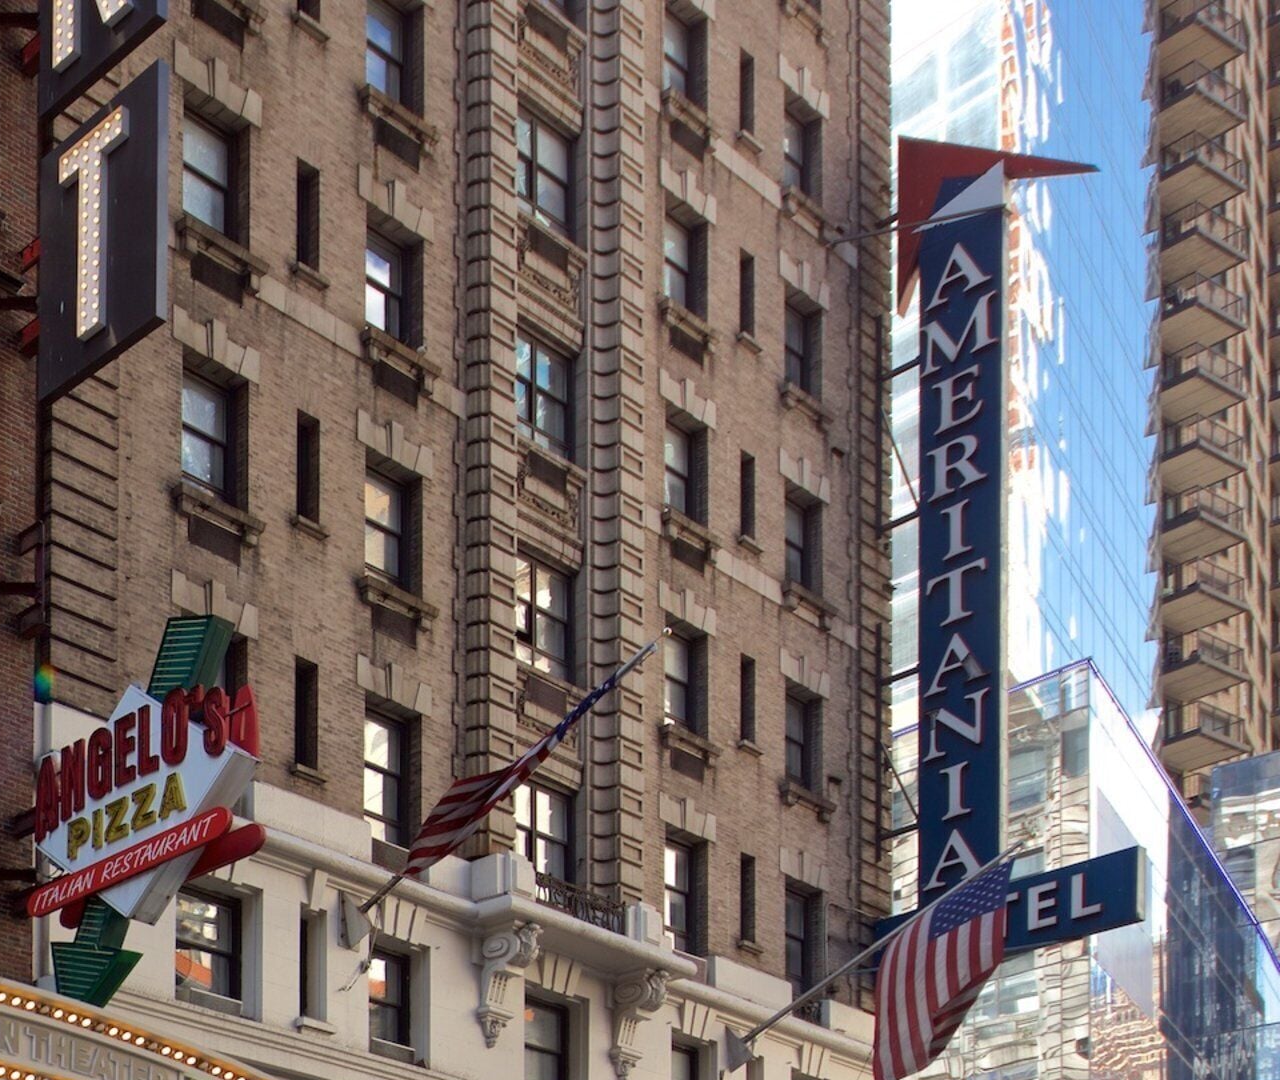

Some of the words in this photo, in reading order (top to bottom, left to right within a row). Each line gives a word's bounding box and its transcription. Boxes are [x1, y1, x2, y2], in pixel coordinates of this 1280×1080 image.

[922, 242, 999, 891] AMERITANIA
[35, 686, 230, 843] ANGELO'S
[67, 772, 187, 861] PIZZA
[34, 867, 95, 912] ITALIAN
[101, 812, 218, 883] RESTAURANT
